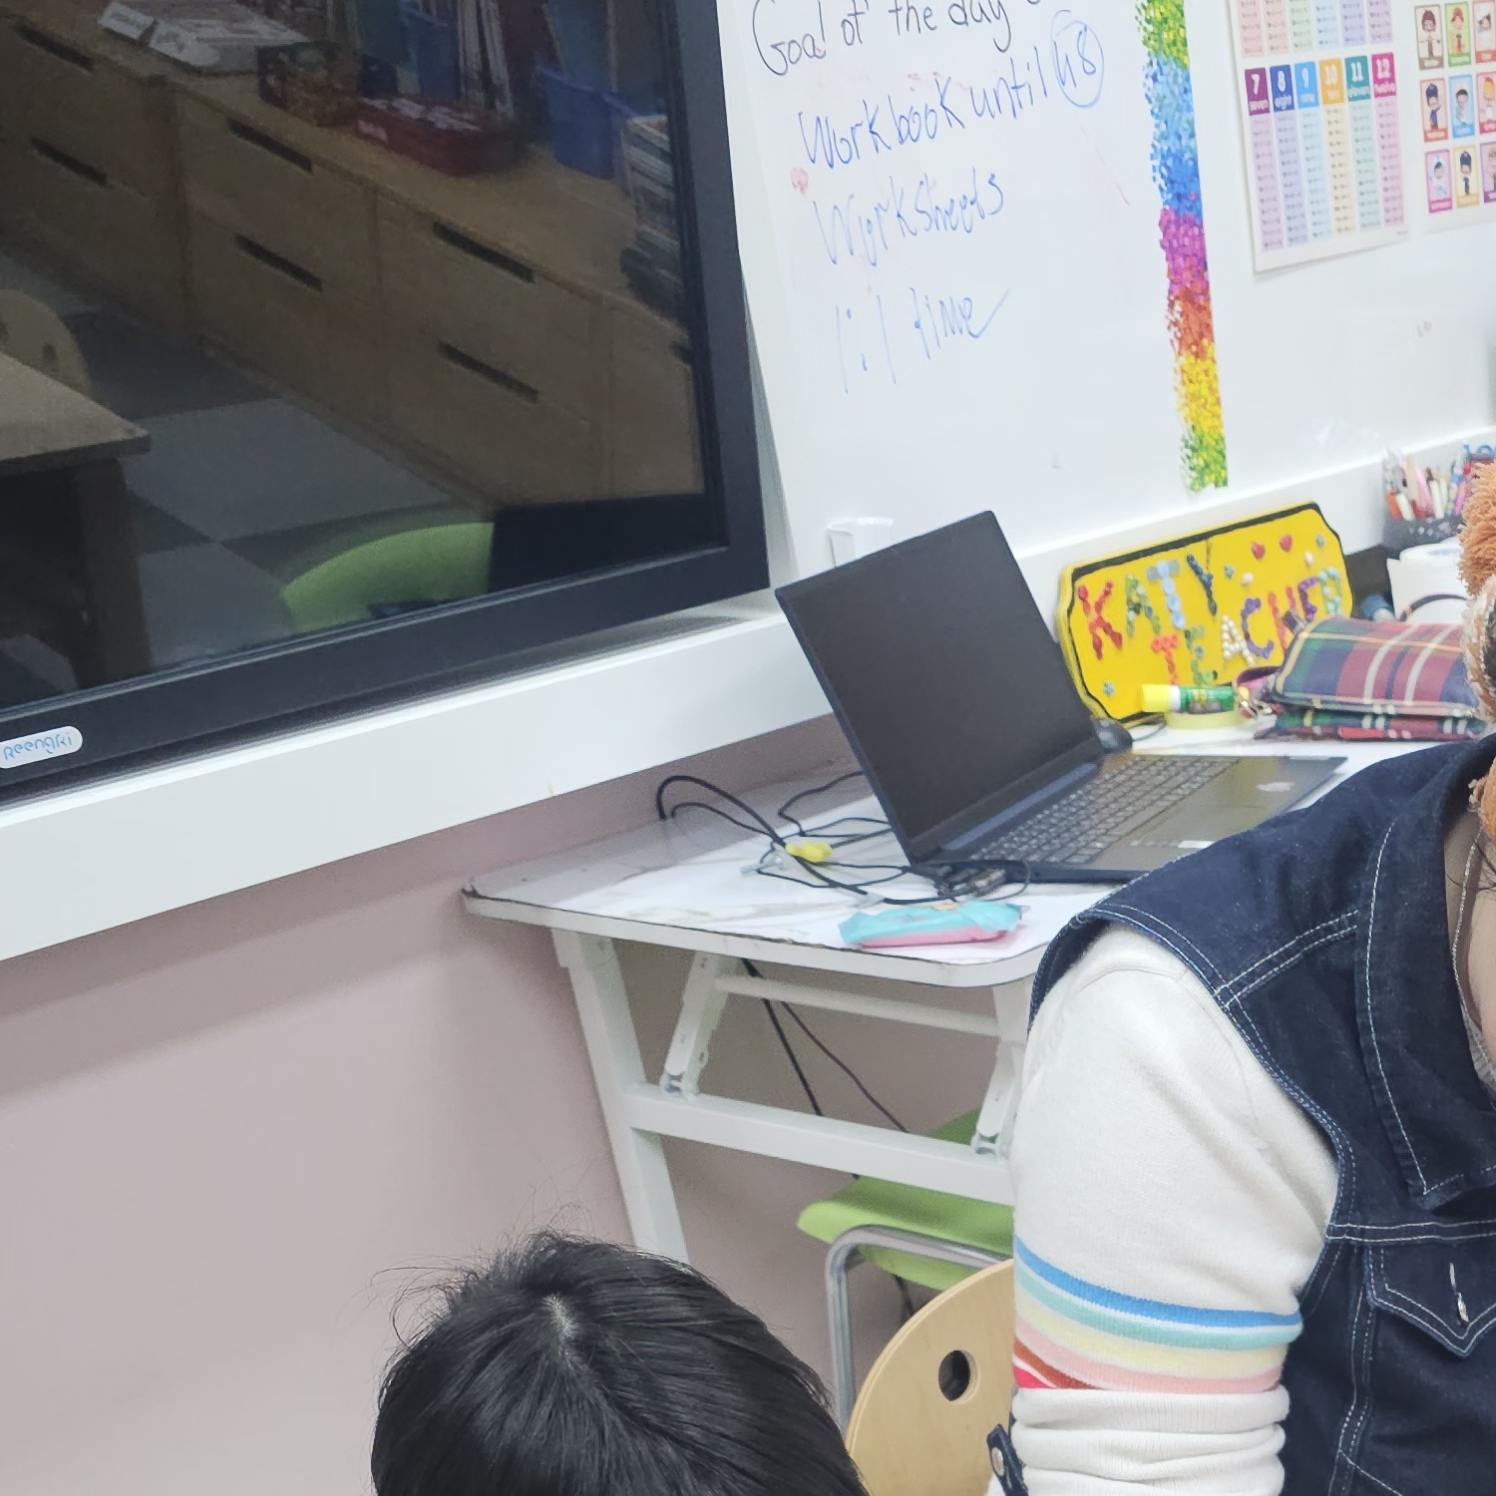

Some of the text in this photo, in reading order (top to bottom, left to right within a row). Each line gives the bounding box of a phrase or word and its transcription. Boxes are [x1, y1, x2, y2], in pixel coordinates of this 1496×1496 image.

[752, 0, 1012, 76] Goal of the day
[799, 77, 965, 168] Workbook
[975, 46, 1048, 119] until
[1077, 551, 1218, 660] KATY
